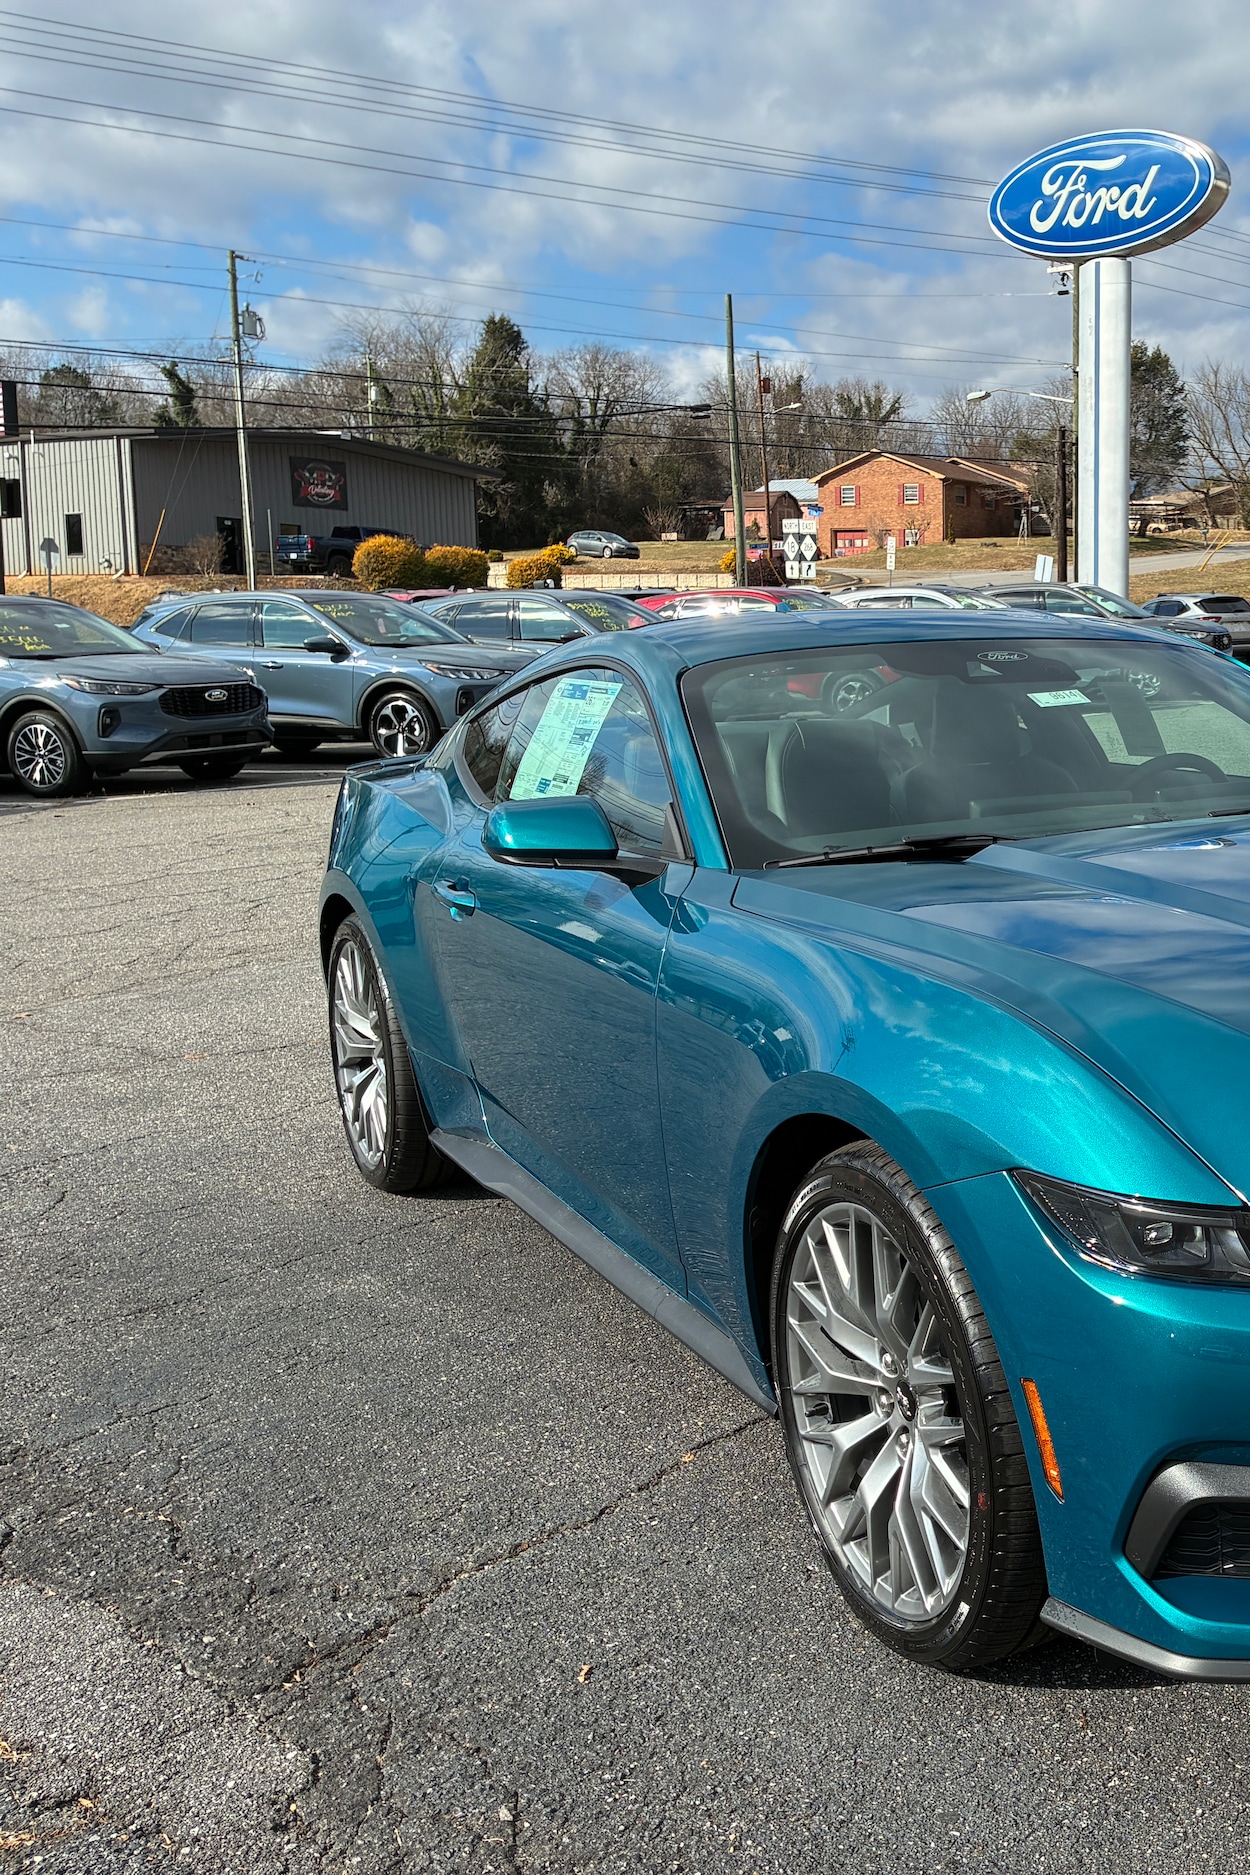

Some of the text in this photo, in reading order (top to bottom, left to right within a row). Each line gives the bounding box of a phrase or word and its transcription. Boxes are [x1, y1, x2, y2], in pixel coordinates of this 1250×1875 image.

[1030, 154, 1161, 234] Ford
[784, 521, 798, 530] NORTH
[802, 521, 814, 531] EAST
[787, 541, 796, 553] 18
[803, 542, 814, 552] 268
[987, 651, 1020, 661] Ford
